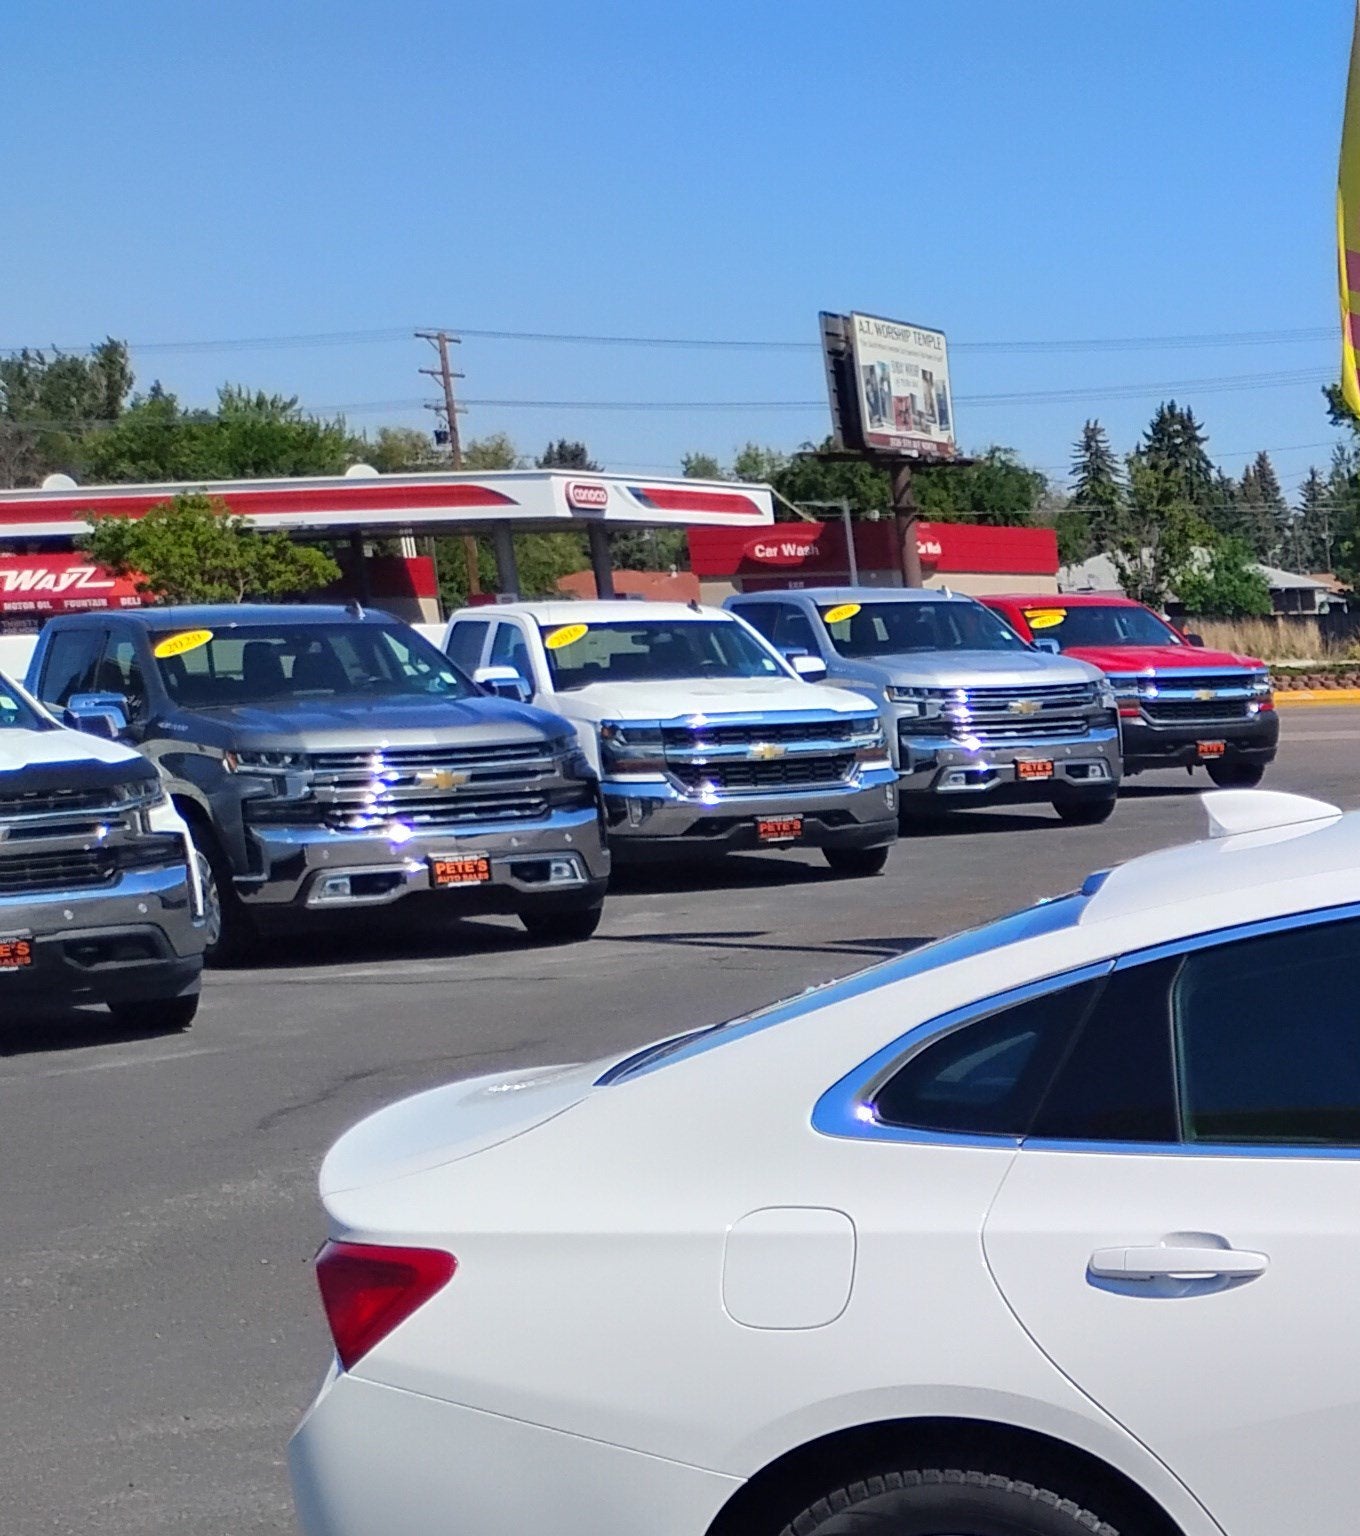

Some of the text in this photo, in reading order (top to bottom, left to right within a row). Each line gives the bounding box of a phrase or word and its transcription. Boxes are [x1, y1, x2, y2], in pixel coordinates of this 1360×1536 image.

[875, 324, 911, 342] WORSHIP
[913, 331, 942, 350] TEMPLE
[755, 543, 819, 557] Car Wash
[3, 597, 142, 610] MOTOR OIL FOUNTAIN DELI
[760, 820, 801, 833] PETE'S
[435, 860, 488, 874] PETE'S
[437, 874, 461, 883] AUTO
